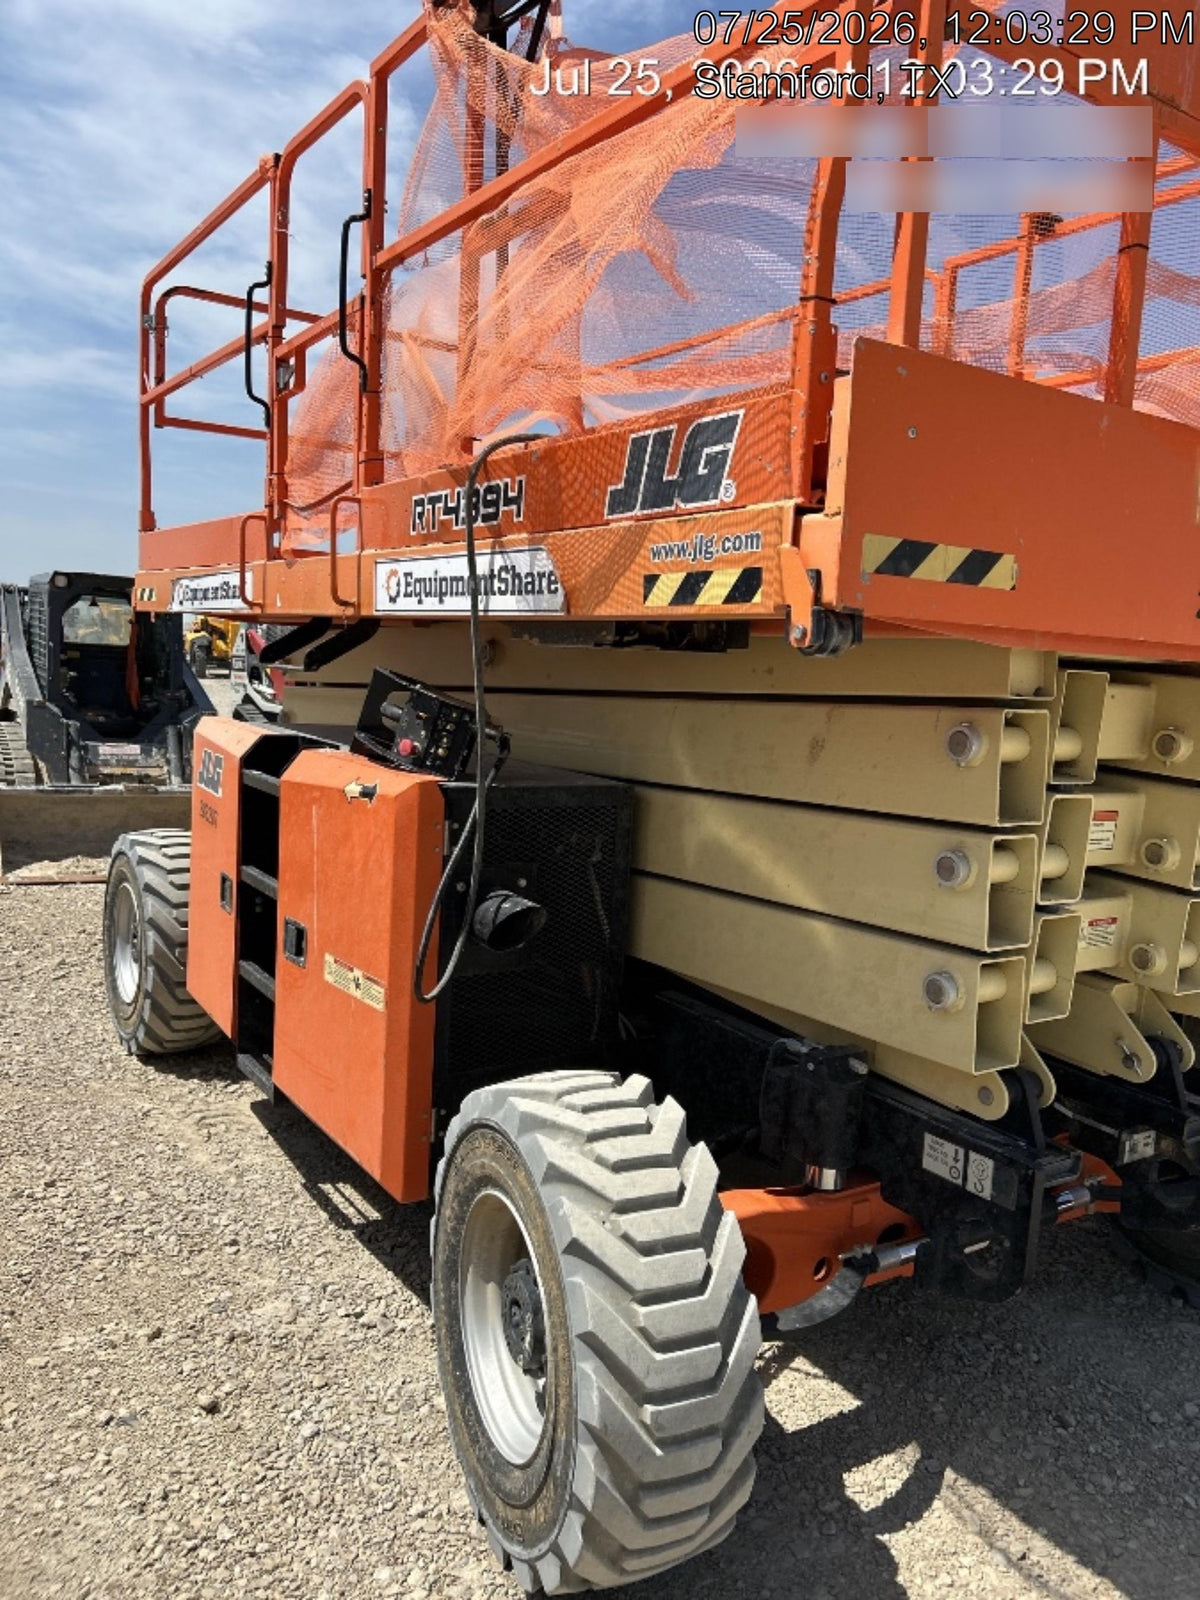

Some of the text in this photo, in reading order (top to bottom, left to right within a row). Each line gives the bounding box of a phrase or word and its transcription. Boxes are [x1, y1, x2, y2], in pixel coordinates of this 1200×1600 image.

[604, 409, 745, 520] JLG
[650, 531, 763, 564] www.jlg.com
[402, 564, 560, 605] EquipmntShare
